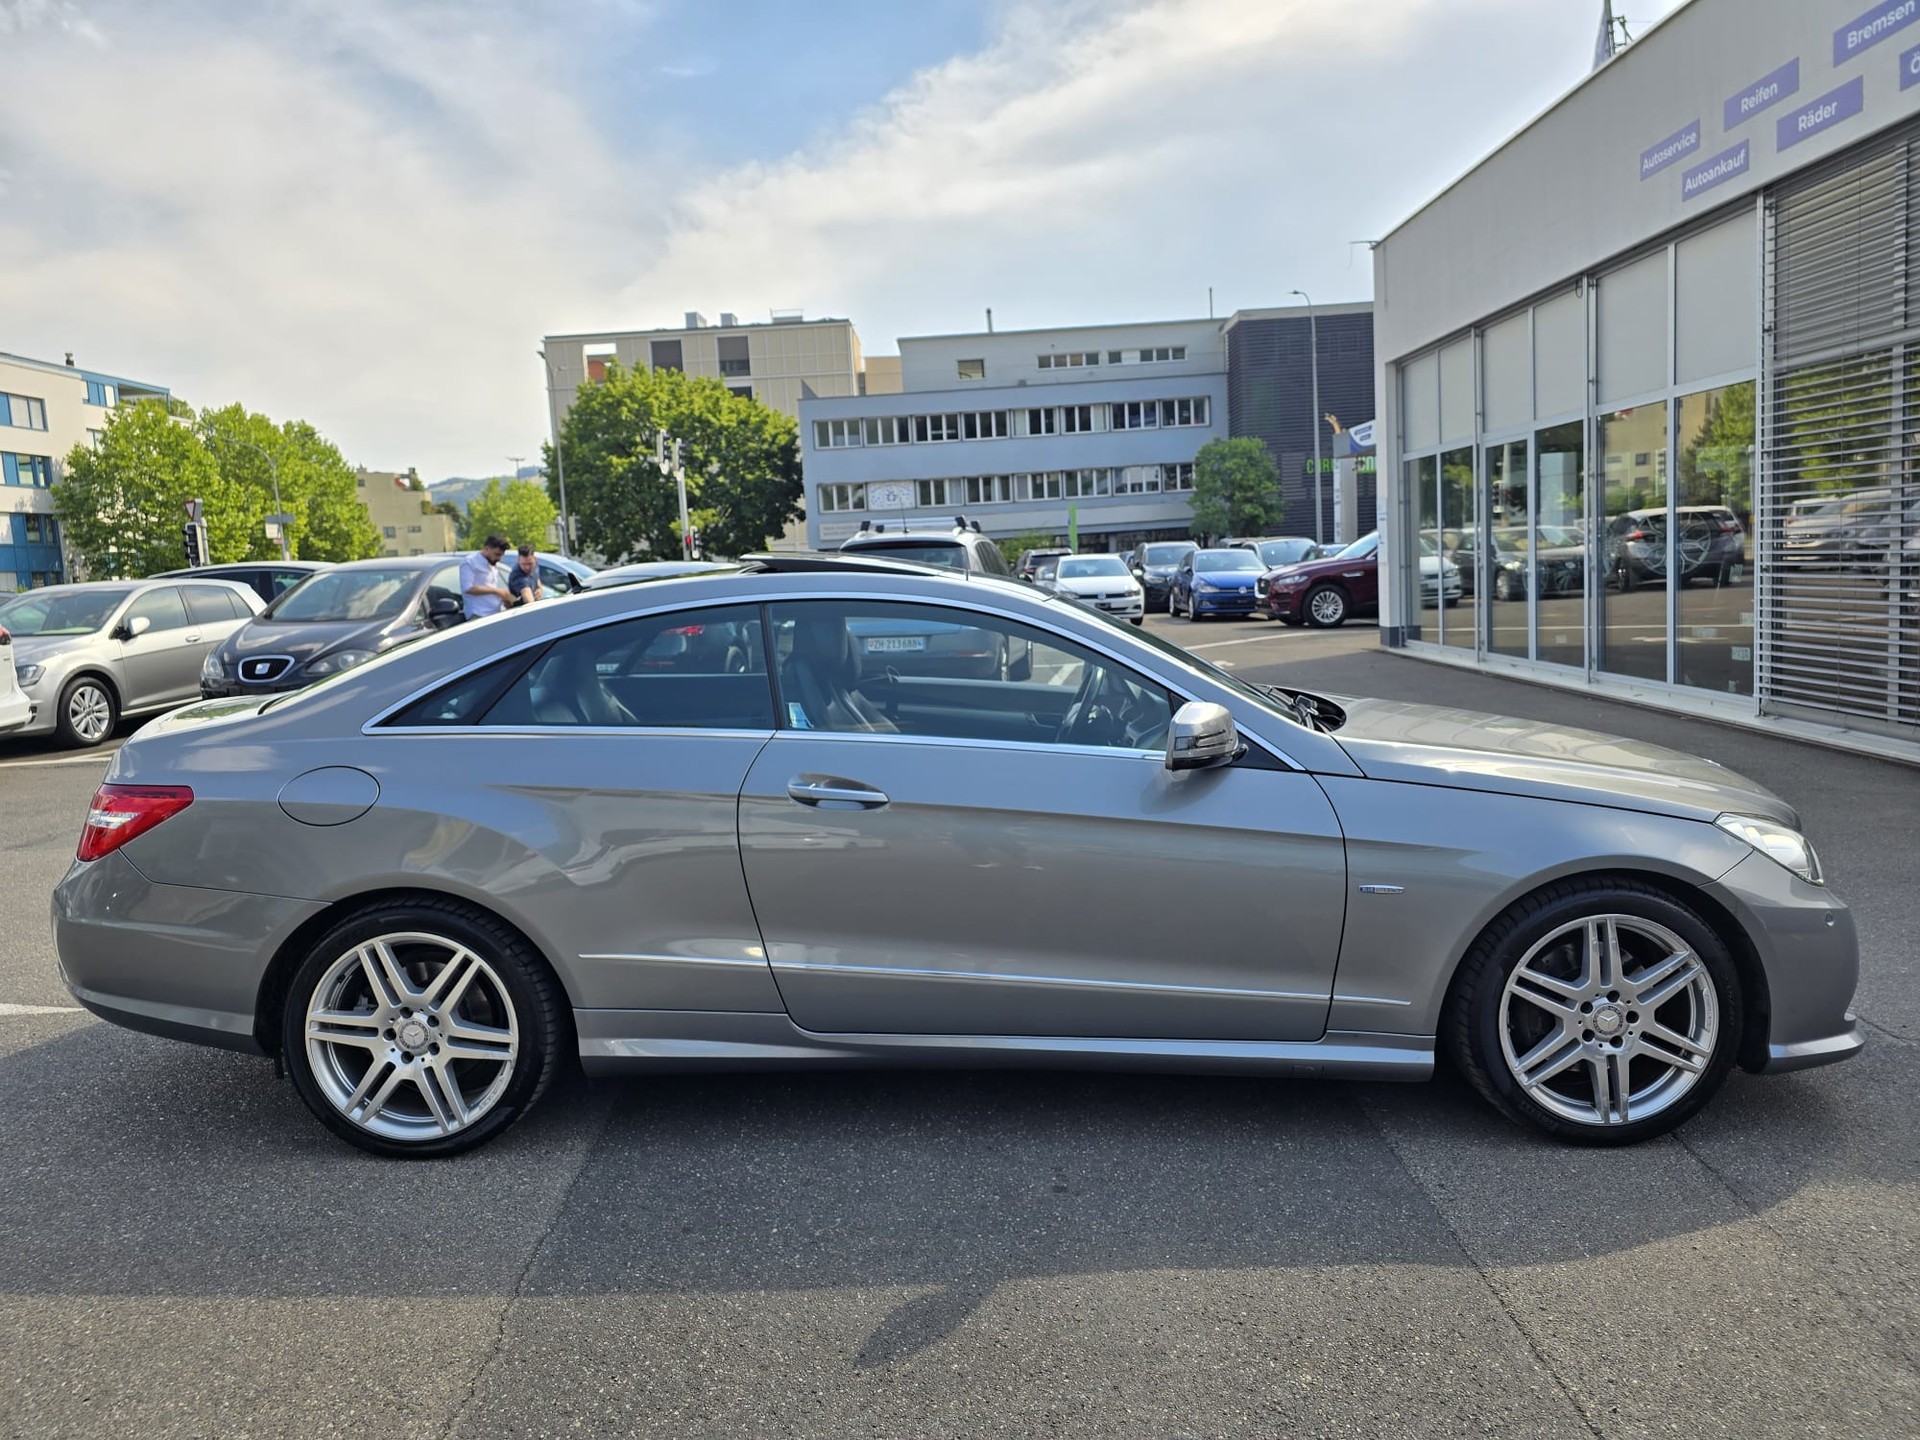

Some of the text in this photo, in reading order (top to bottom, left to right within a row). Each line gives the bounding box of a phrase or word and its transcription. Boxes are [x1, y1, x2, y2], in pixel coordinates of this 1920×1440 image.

[1847, 0, 1915, 49] Bremsen
[1741, 82, 1778, 113] Reifen
[1798, 101, 1838, 132] Räder
[1641, 132, 1697, 172] Autoservice
[1684, 148, 1746, 193] Autoankauf
